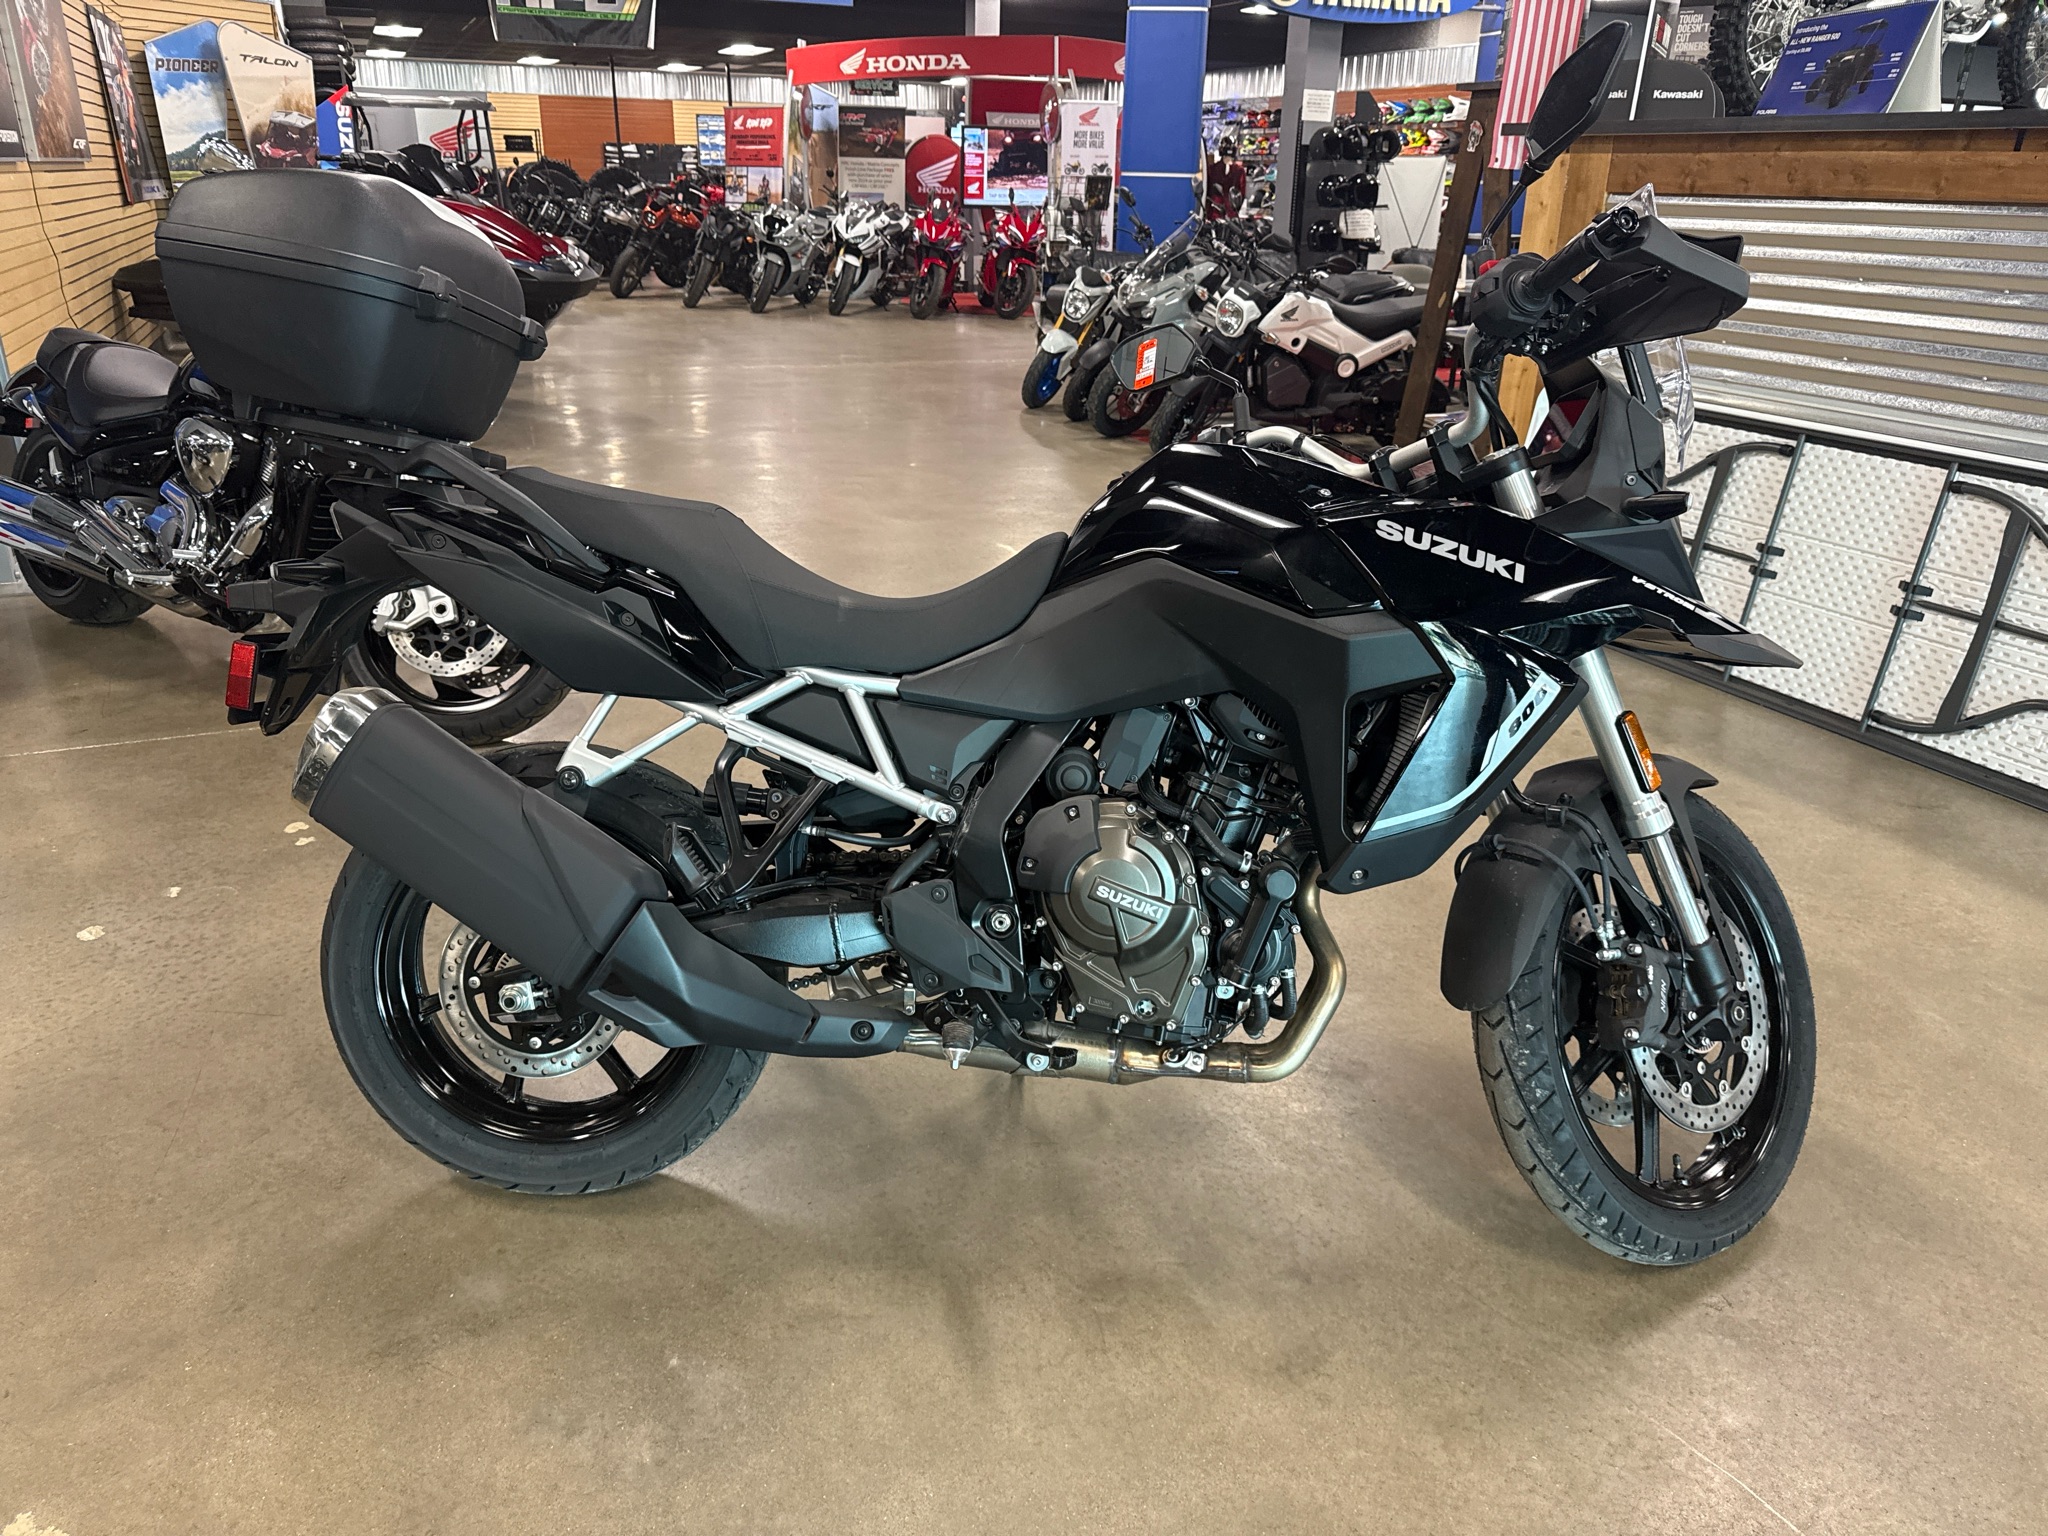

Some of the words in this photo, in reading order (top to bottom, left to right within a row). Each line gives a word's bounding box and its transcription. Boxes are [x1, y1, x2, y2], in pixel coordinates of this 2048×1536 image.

[1680, 14, 1703, 24] TOUGH
[1677, 22, 1710, 33] DOESN'T
[1675, 33, 1691, 42] CUT
[1674, 41, 1709, 52] CORNERS
[155, 57, 219, 74] PIONEER
[239, 53, 299, 69] TALON
[866, 53, 971, 74] HONDA
[1653, 89, 1704, 99] Kawasaki
[1004, 117, 1041, 126] HONDA
[1074, 130, 1088, 140] MORE
[1089, 130, 1104, 140] BIKES
[1073, 140, 1087, 149] MORE
[1089, 140, 1104, 149] VALUE
[917, 186, 957, 195] HONDA
[1375, 519, 1525, 584] SUZUKI
[1096, 885, 1164, 919] SUZUKI
